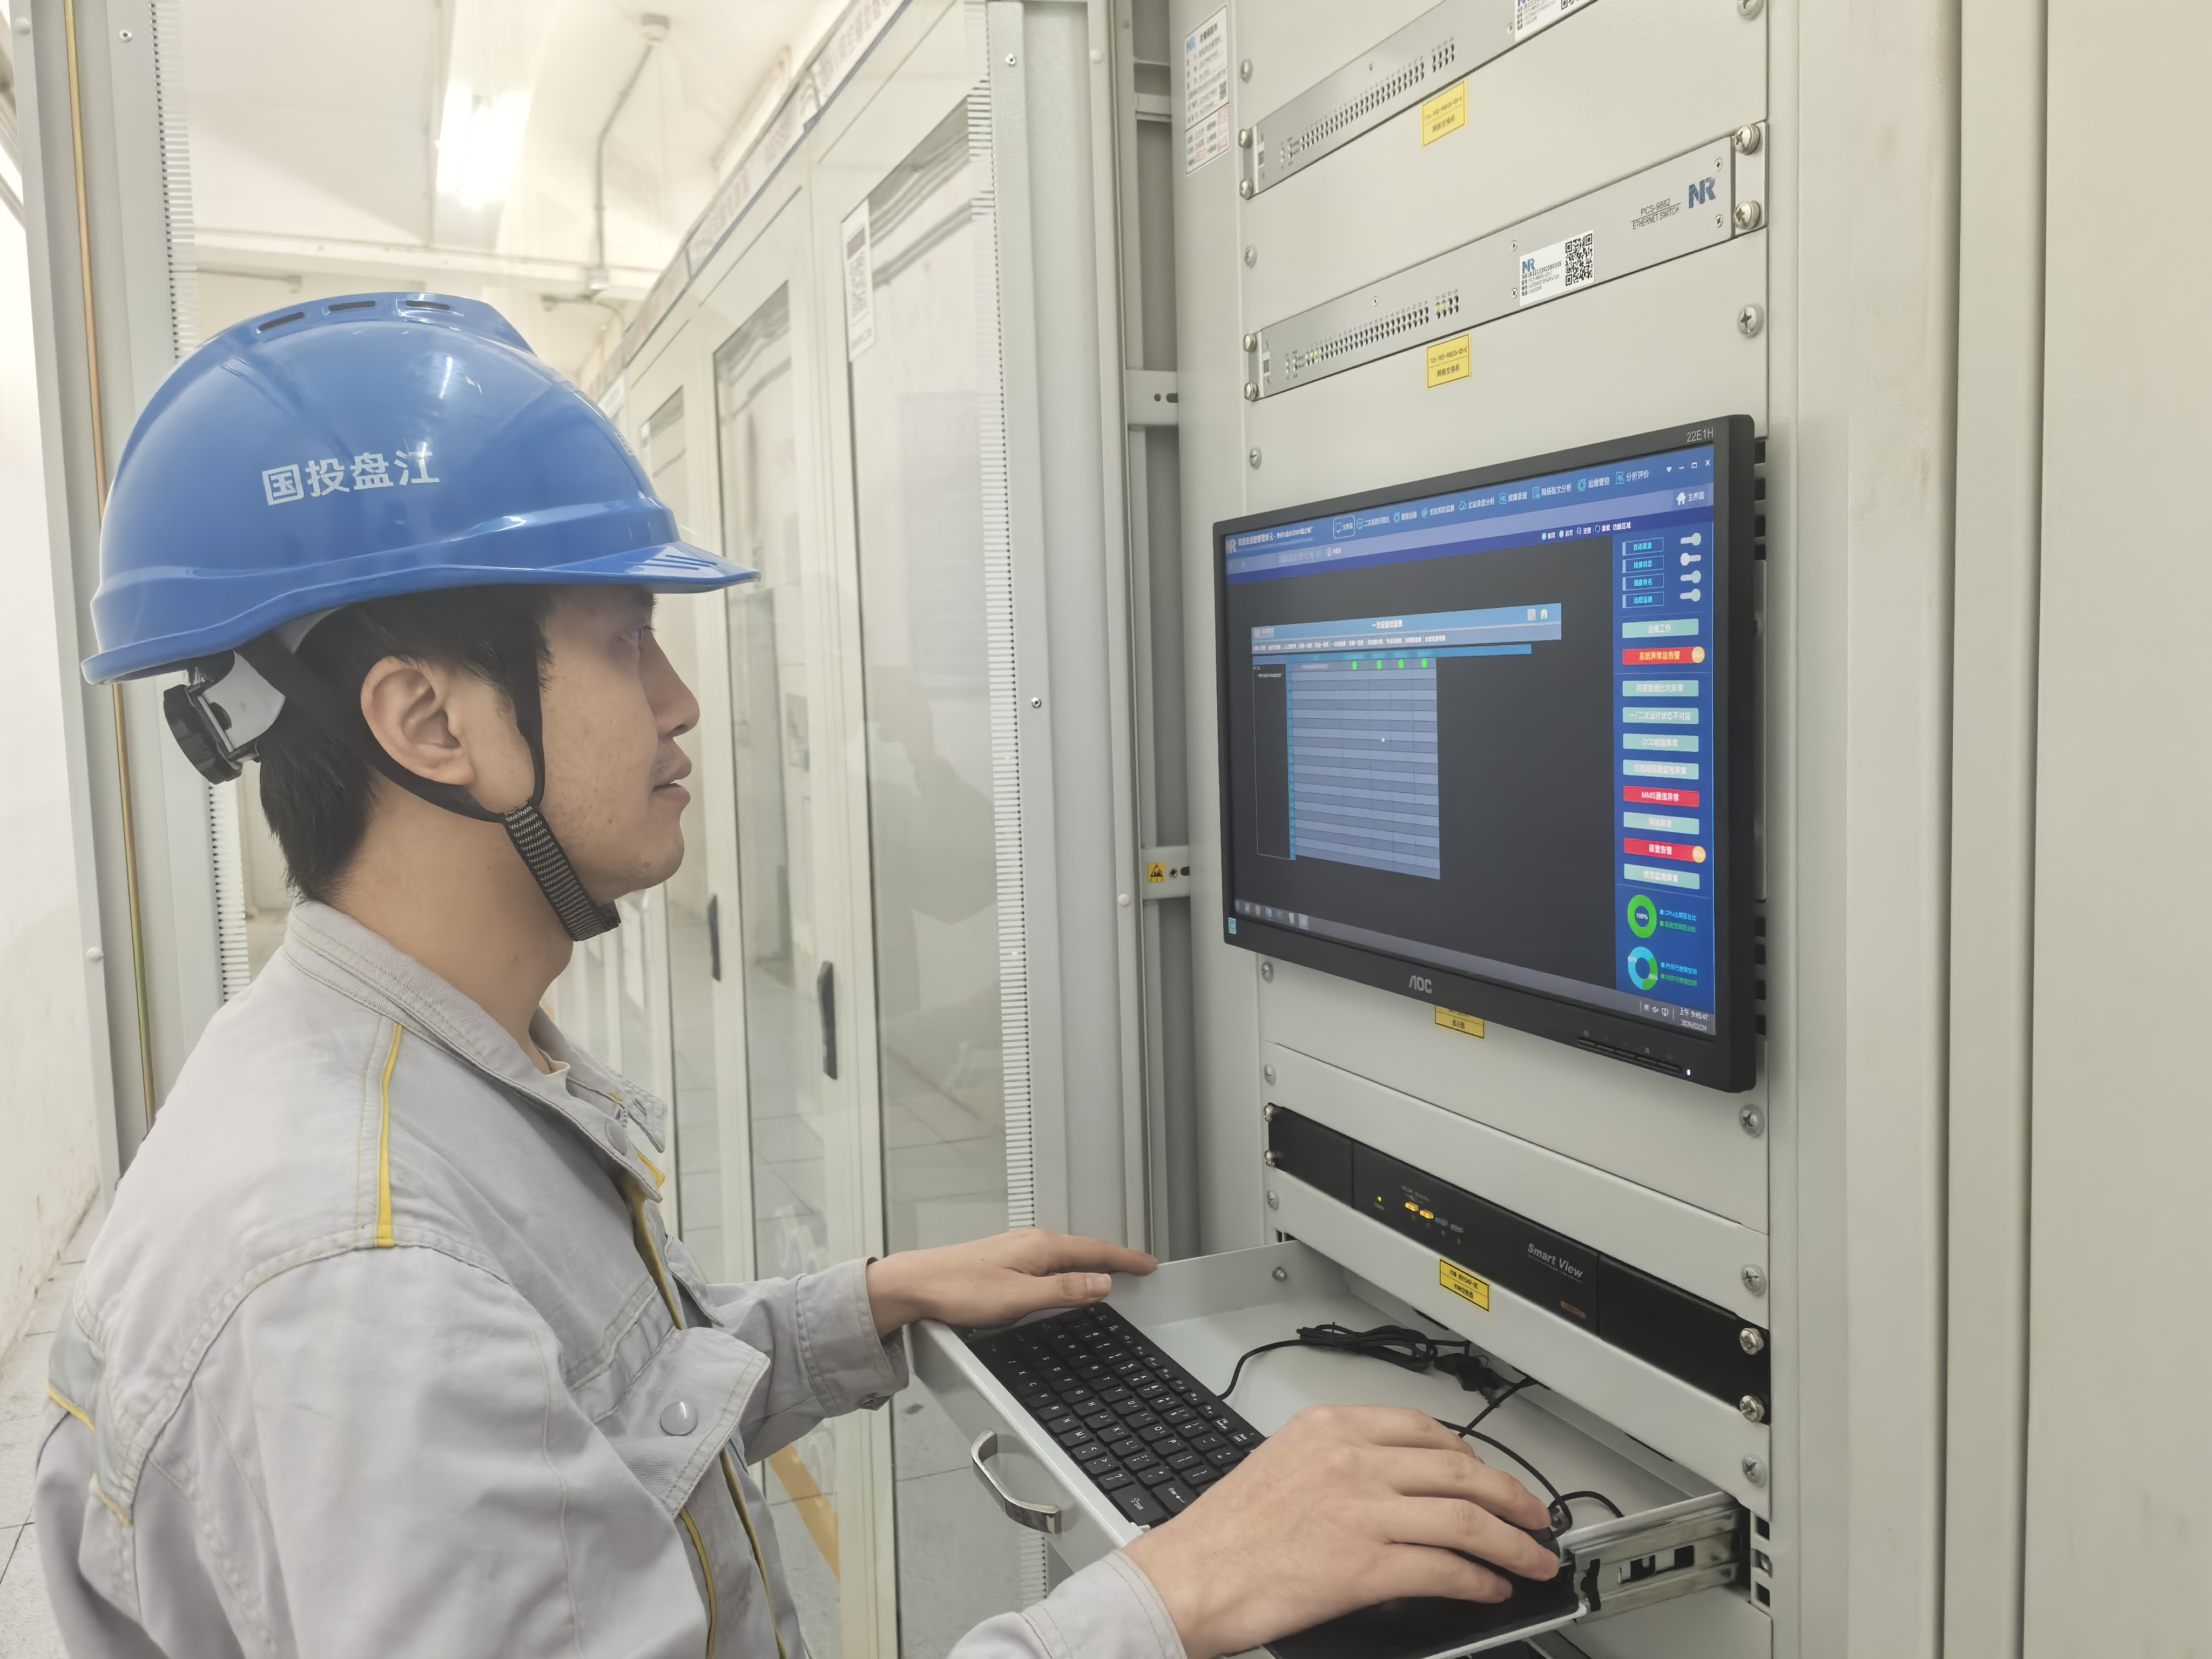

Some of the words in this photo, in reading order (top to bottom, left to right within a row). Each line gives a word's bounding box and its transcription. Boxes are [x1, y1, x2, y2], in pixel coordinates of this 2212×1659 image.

[1689, 177, 1716, 209] NR
[1633, 213, 1659, 230] ETHERNET
[1660, 206, 1680, 220] SWITCH
[1522, 258, 1535, 274] NR
[1687, 427, 1714, 443] 22E1H
[262, 441, 440, 505] 国投盘江
[1626, 469, 1649, 482] 分析评价
[1541, 483, 1572, 497] 网络报文分析
[1687, 491, 1704, 502] 主界面
[1613, 521, 1631, 531] 功能区域
[1639, 650, 1680, 661] 系统异常总告警
[1641, 791, 1680, 802] MMS通信异常
[1649, 844, 1673, 855] 装置告警
[1636, 912, 1648, 920] 100%
[1408, 975, 1432, 994] AOC
[1680, 1007, 1689, 1016] 上午
[1528, 1243, 1556, 1265] Smart
[1559, 1257, 1583, 1278] View
